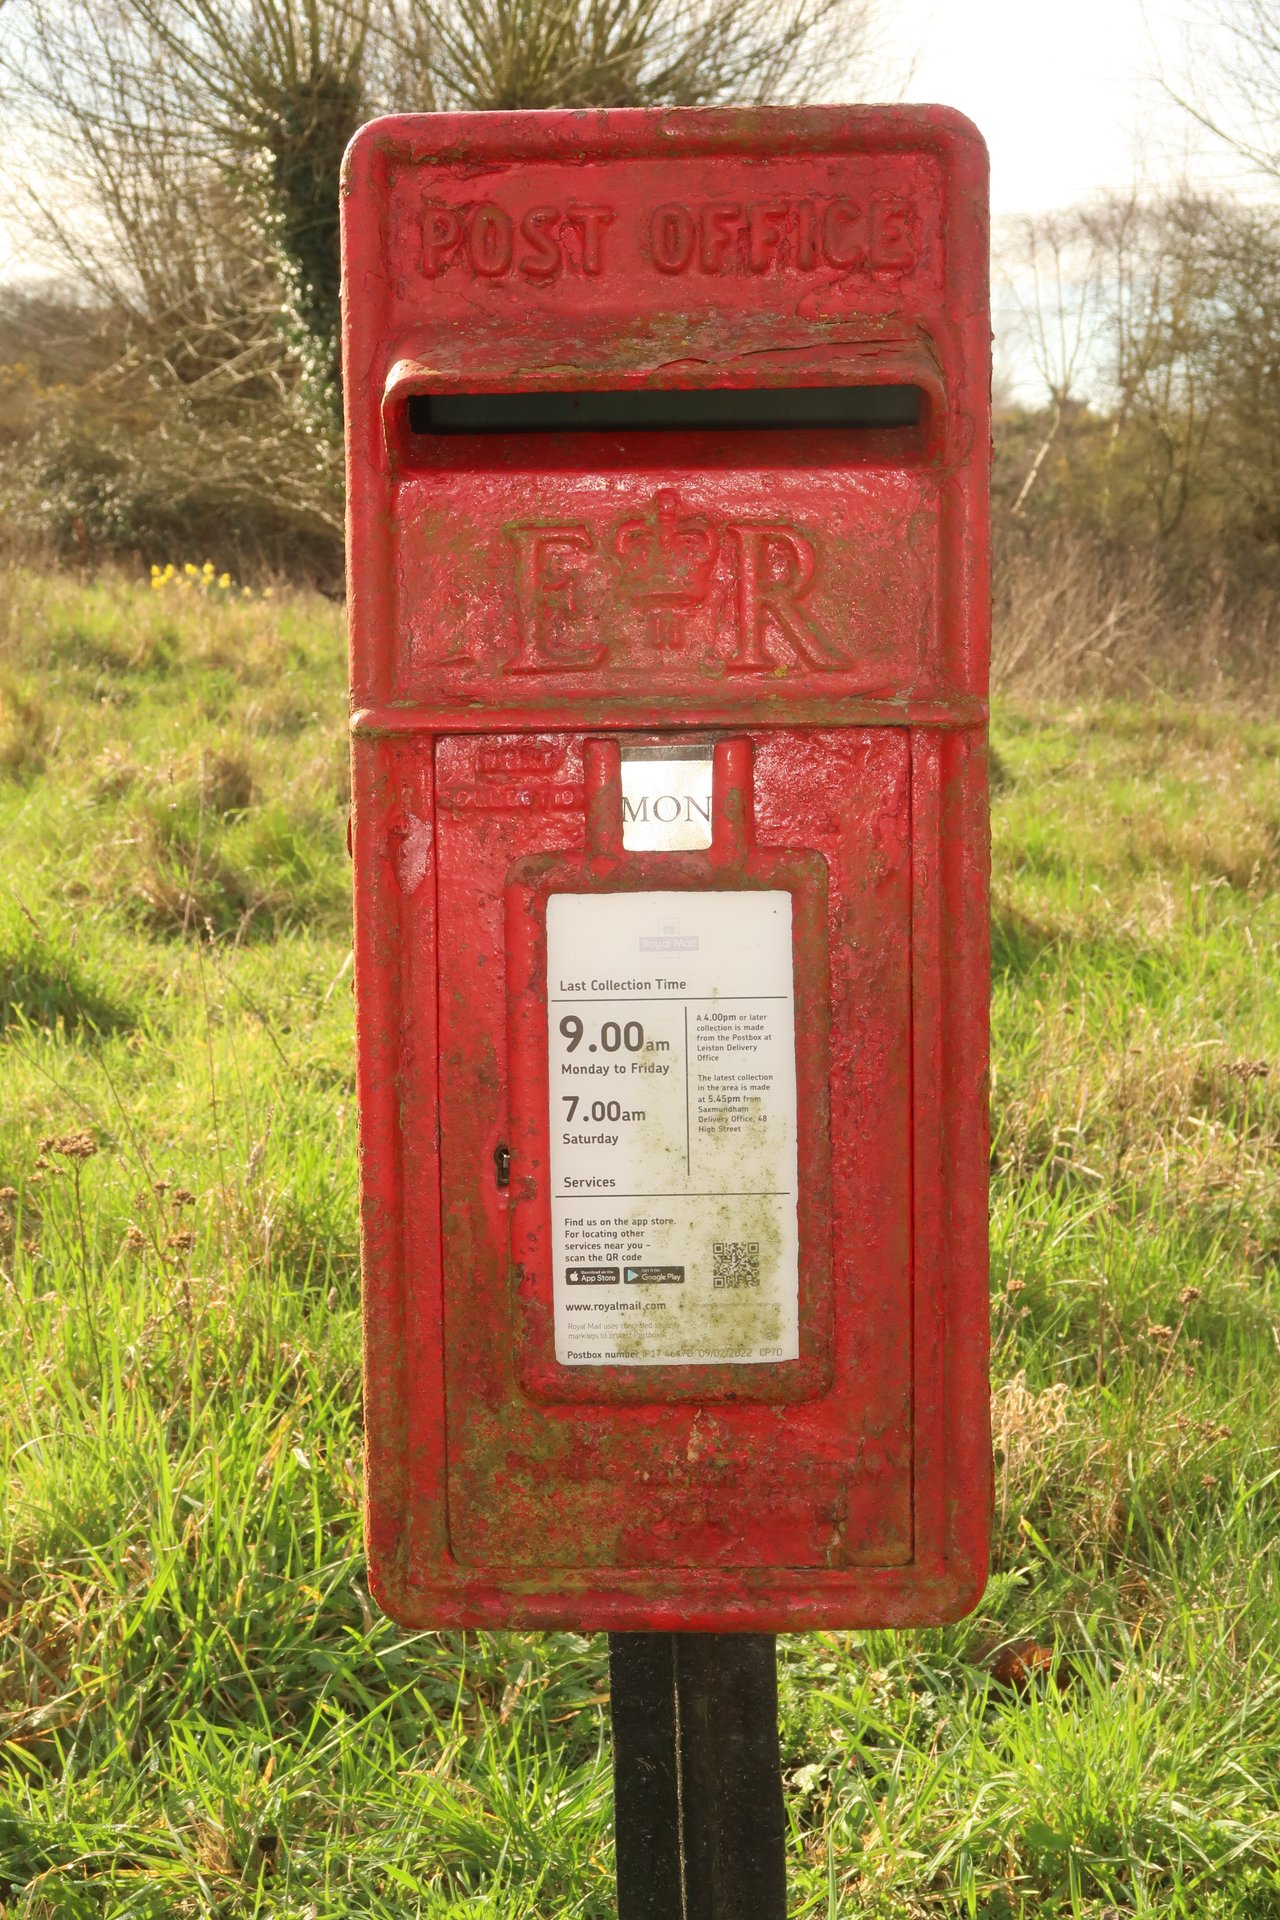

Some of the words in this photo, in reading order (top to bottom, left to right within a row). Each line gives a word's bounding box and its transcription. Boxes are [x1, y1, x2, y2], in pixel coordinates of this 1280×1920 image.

[417, 201, 618, 279] POST
[648, 199, 917, 278] OFFICE
[503, 521, 609, 675] E
[722, 521, 855, 675] R
[622, 796, 712, 823] MON
[560, 980, 587, 991] Last
[591, 979, 651, 991] Collection
[655, 978, 686, 990] Time
[704, 1013, 737, 1022] 4.00pm
[697, 1024, 732, 1032] collection
[559, 1015, 670, 1053] 9.00am
[727, 1043, 757, 1052] Delivery
[561, 1064, 610, 1076] Monday
[614, 1064, 627, 1075] to
[631, 1063, 670, 1075] Friday
[698, 1074, 711, 1082] The
[738, 1073, 773, 1081] collection
[708, 1094, 741, 1103] 5.45pm
[561, 1095, 646, 1122] 7.00am
[698, 1115, 728, 1123] Delivery
[698, 1125, 715, 1133] High
[562, 1133, 619, 1146] Saturday
[563, 1176, 616, 1188] Services
[564, 1218, 584, 1226] Find
[631, 1219, 648, 1227] app
[564, 1230, 579, 1238] For
[582, 1230, 618, 1239] locating
[565, 1242, 601, 1250] services
[565, 1254, 585, 1262] scan
[606, 1253, 619, 1261] QR
[621, 1253, 642, 1261] code
[581, 1275, 595, 1283] App
[641, 1273, 666, 1281] Google
[667, 1273, 681, 1281] Play
[565, 1302, 667, 1312] www.royalmail.com
[568, 1351, 602, 1359] Postbox
[605, 1350, 638, 1358] number
